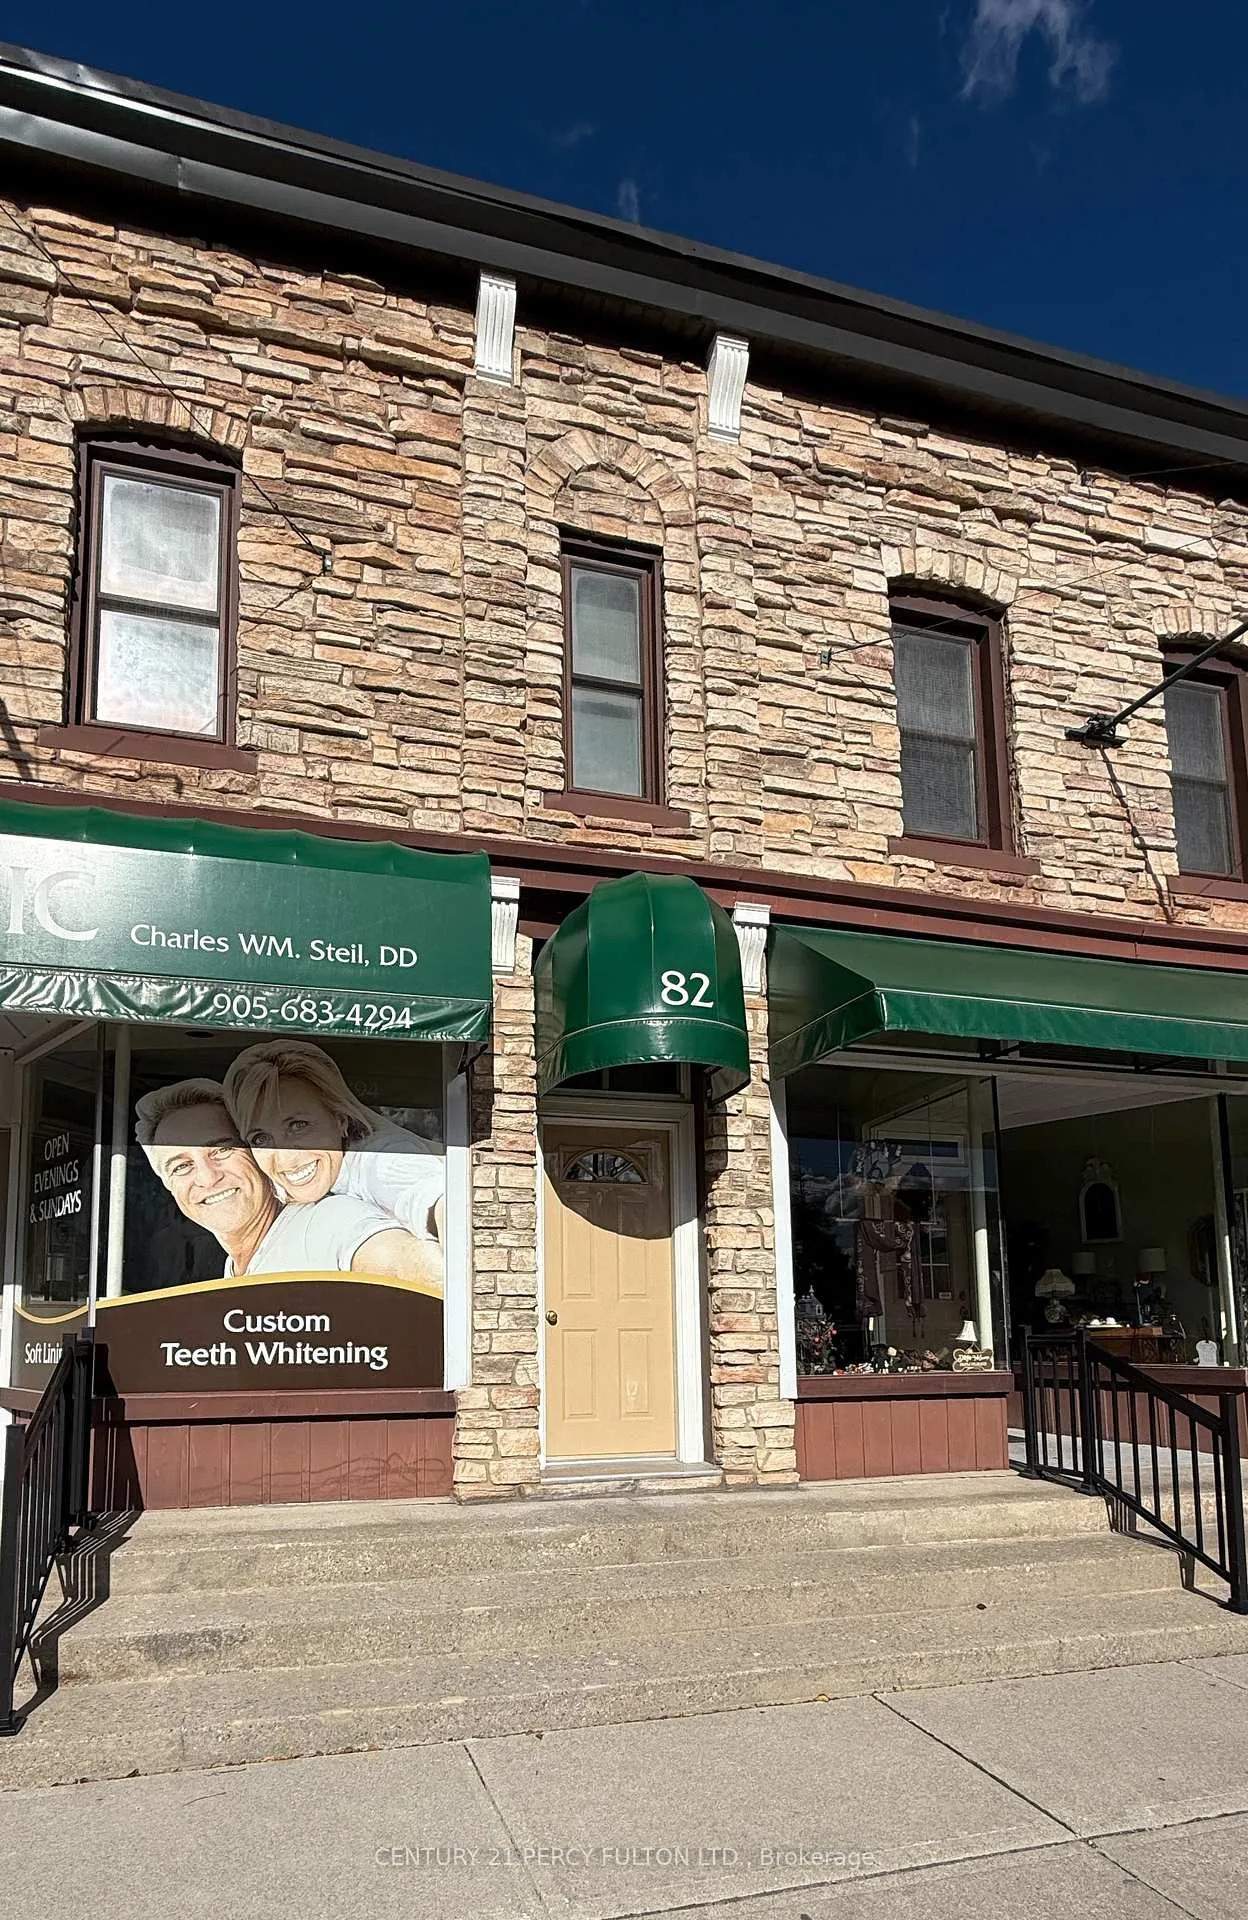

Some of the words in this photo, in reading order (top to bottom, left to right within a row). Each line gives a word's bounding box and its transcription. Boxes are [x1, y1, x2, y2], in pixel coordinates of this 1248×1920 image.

[130, 924, 230, 953] Charles
[238, 932, 301, 959] WM.
[309, 939, 370, 967] Steil,
[379, 945, 418, 968] DD
[661, 970, 714, 1008] 82
[213, 993, 413, 1030] 905-683-4294
[44, 1132, 70, 1160] OPEN
[34, 1159, 79, 1193] EVENINGS
[29, 1203, 38, 1224] &
[39, 1189, 82, 1222] SUNDAYS
[223, 1309, 330, 1333] Custom
[24, 1342, 42, 1364] Soft
[160, 1342, 237, 1366] Teeth
[244, 1341, 389, 1371] Whitening
